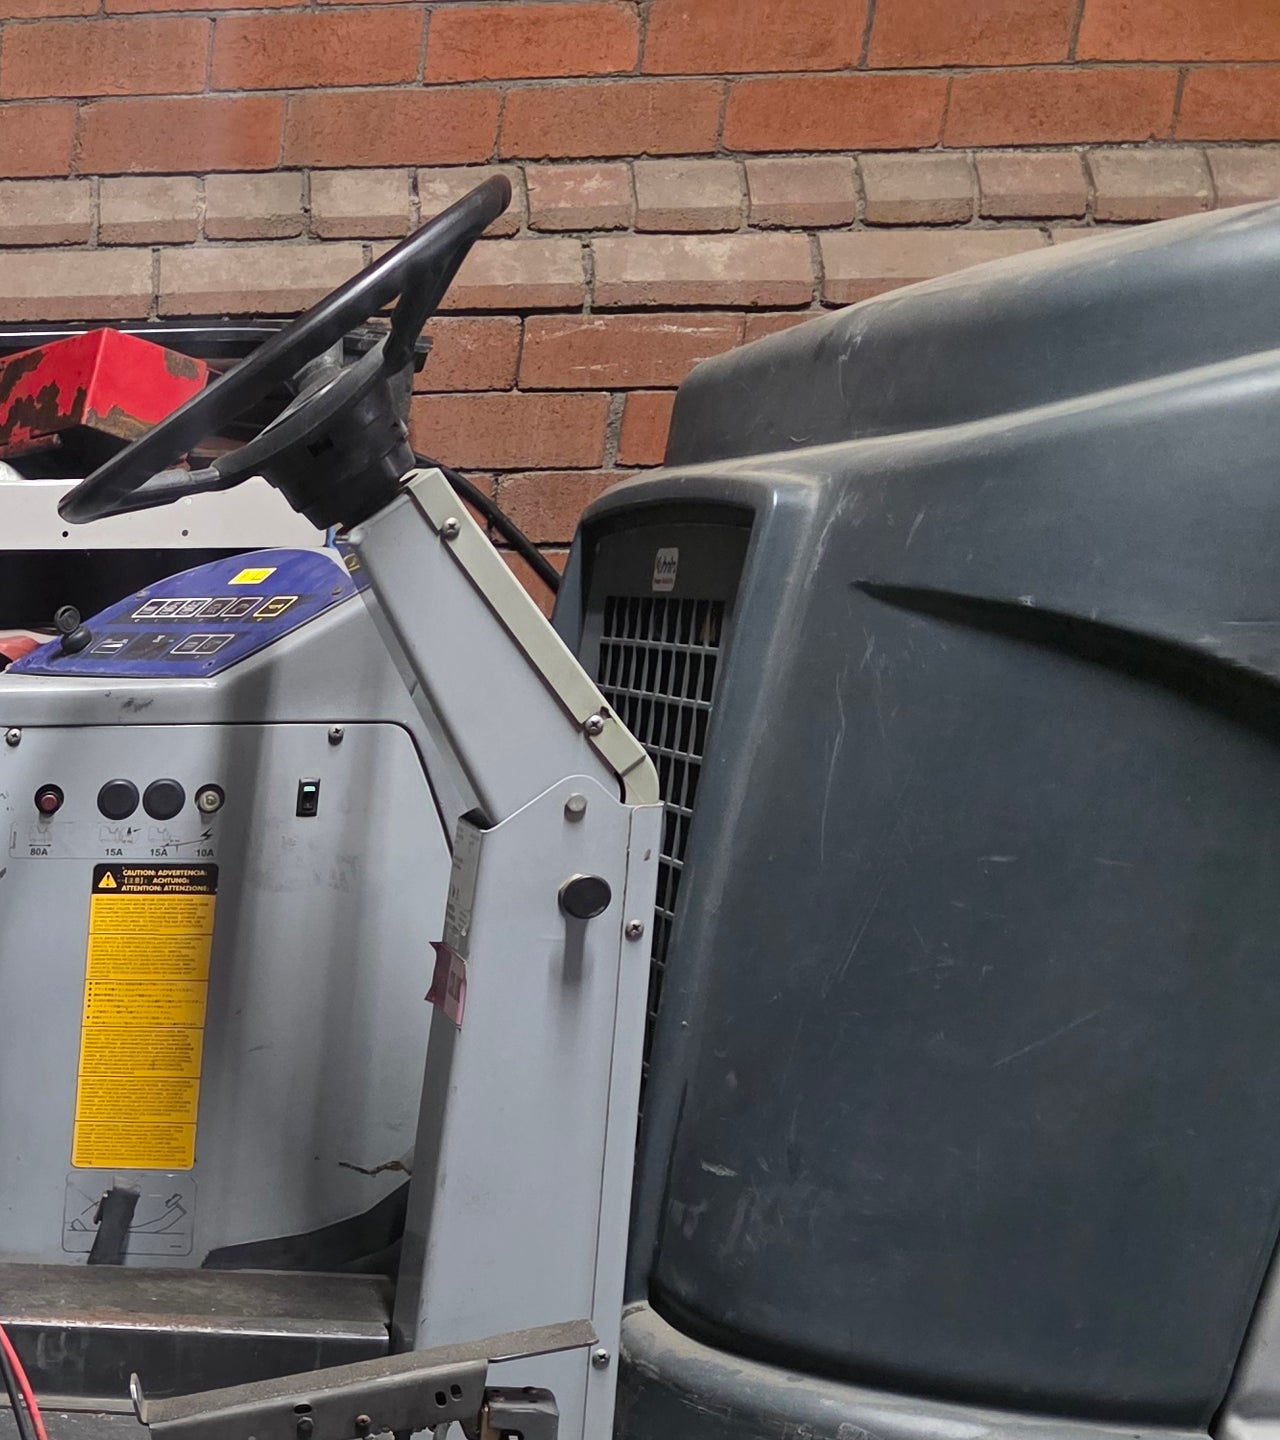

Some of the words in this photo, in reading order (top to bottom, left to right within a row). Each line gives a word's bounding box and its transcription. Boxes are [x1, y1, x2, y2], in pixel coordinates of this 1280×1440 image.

[30, 847, 48, 856] 80A
[104, 848, 123, 857] 15A
[150, 848, 168, 857] 15A
[196, 848, 214, 857] 10A
[122, 869, 156, 877] CAUTION:
